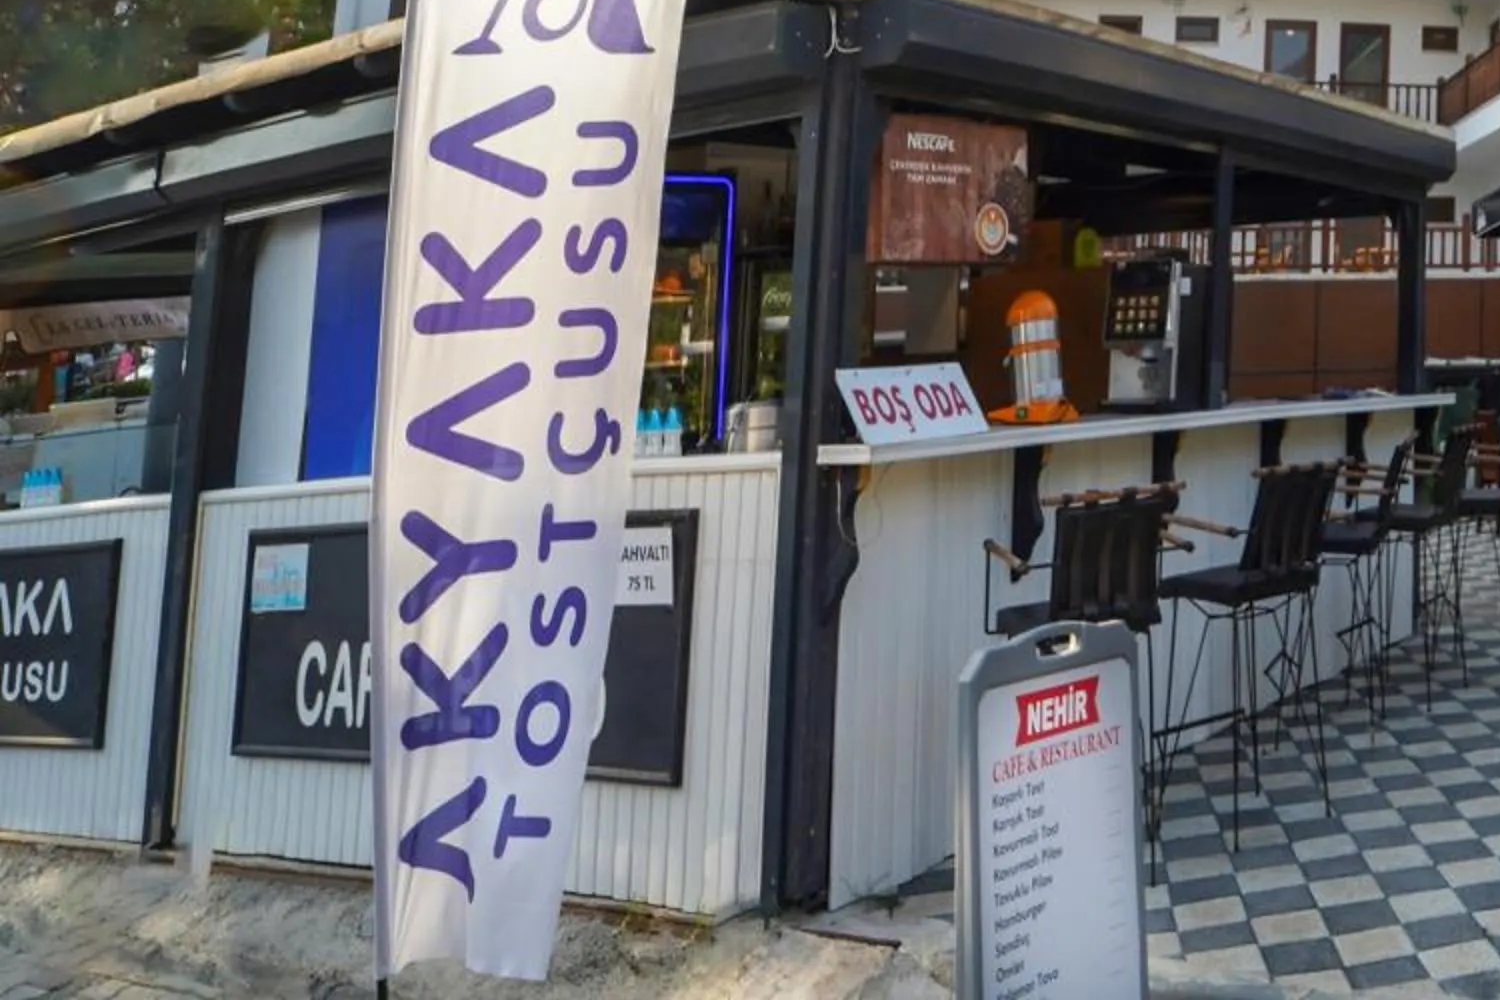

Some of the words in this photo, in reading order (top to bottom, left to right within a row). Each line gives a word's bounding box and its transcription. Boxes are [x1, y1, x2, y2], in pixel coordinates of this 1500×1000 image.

[852, 385, 917, 434] BOŞ
[913, 381, 973, 421] ODA
[494, 120, 638, 859] TOSTÇUSU
[1026, 685, 1088, 737] NEHİR
[1039, 724, 1122, 769] RESTAURANT
